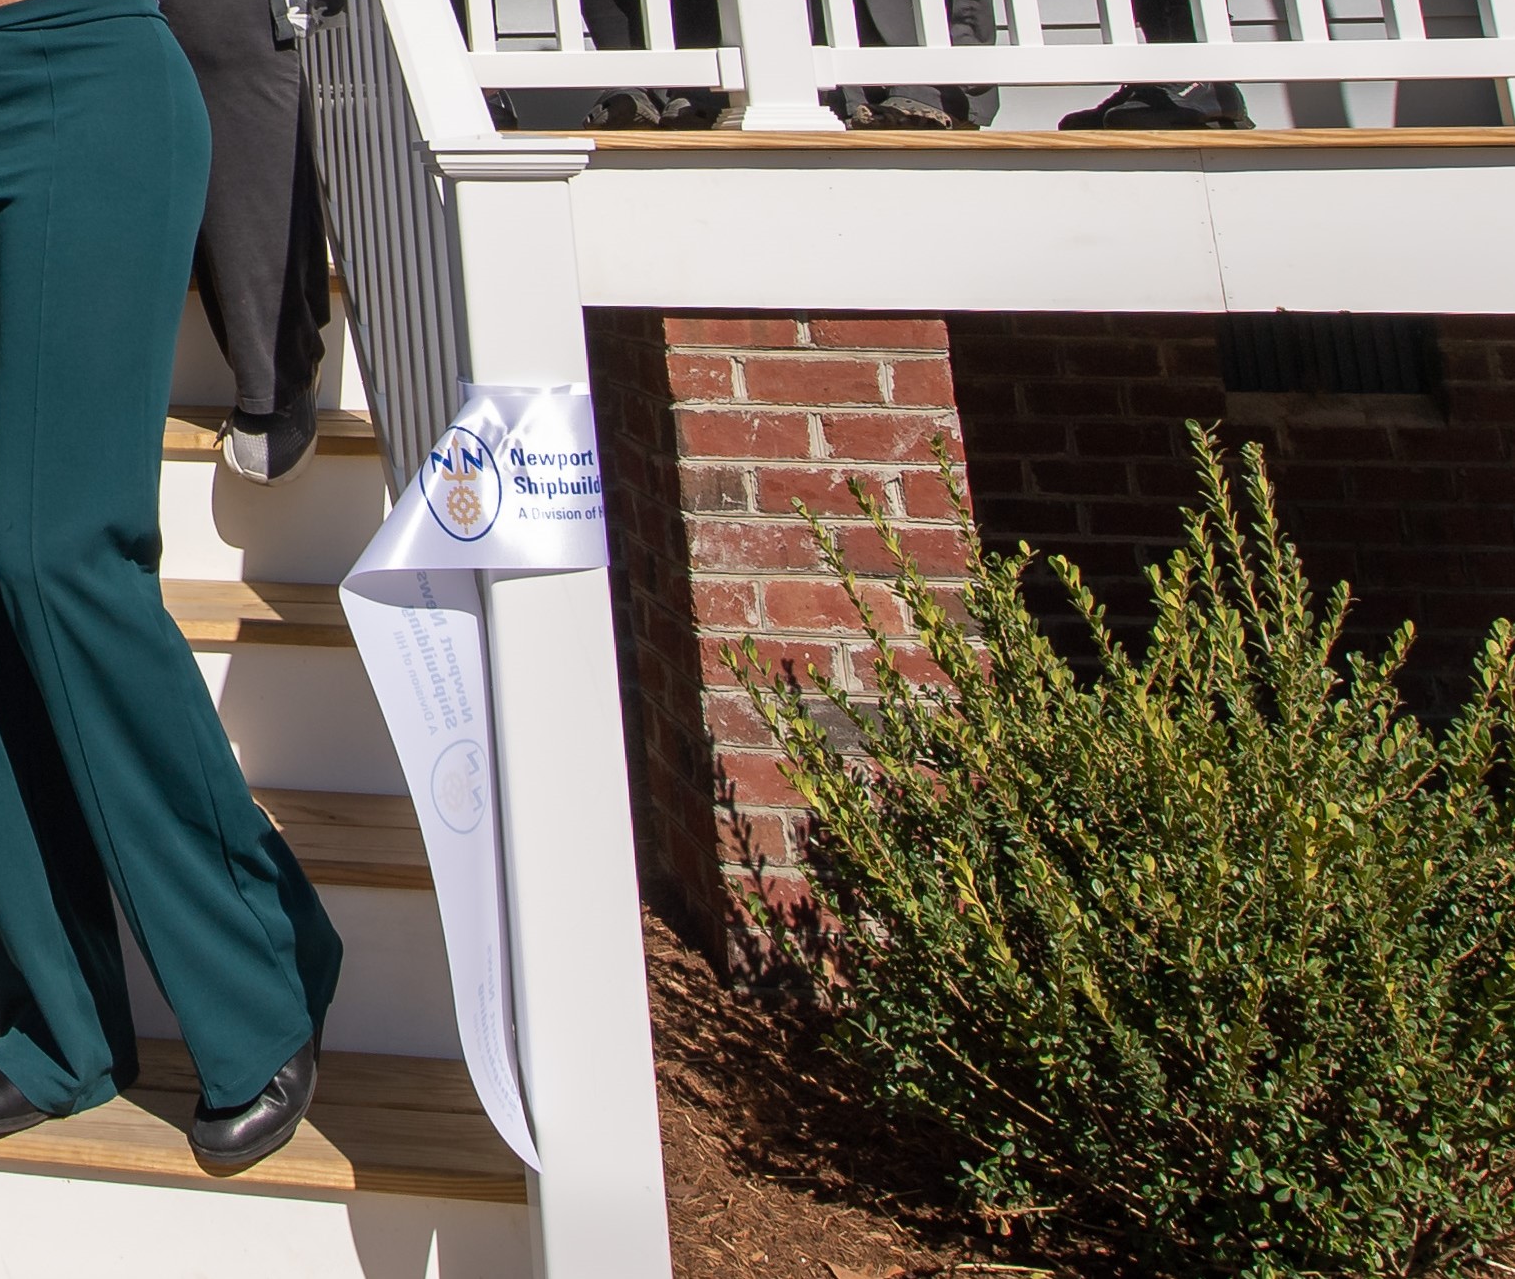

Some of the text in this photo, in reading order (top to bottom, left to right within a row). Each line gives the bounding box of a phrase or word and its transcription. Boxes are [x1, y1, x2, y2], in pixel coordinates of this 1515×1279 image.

[510, 447, 595, 468] Newport
[518, 506, 597, 520] A Division of
